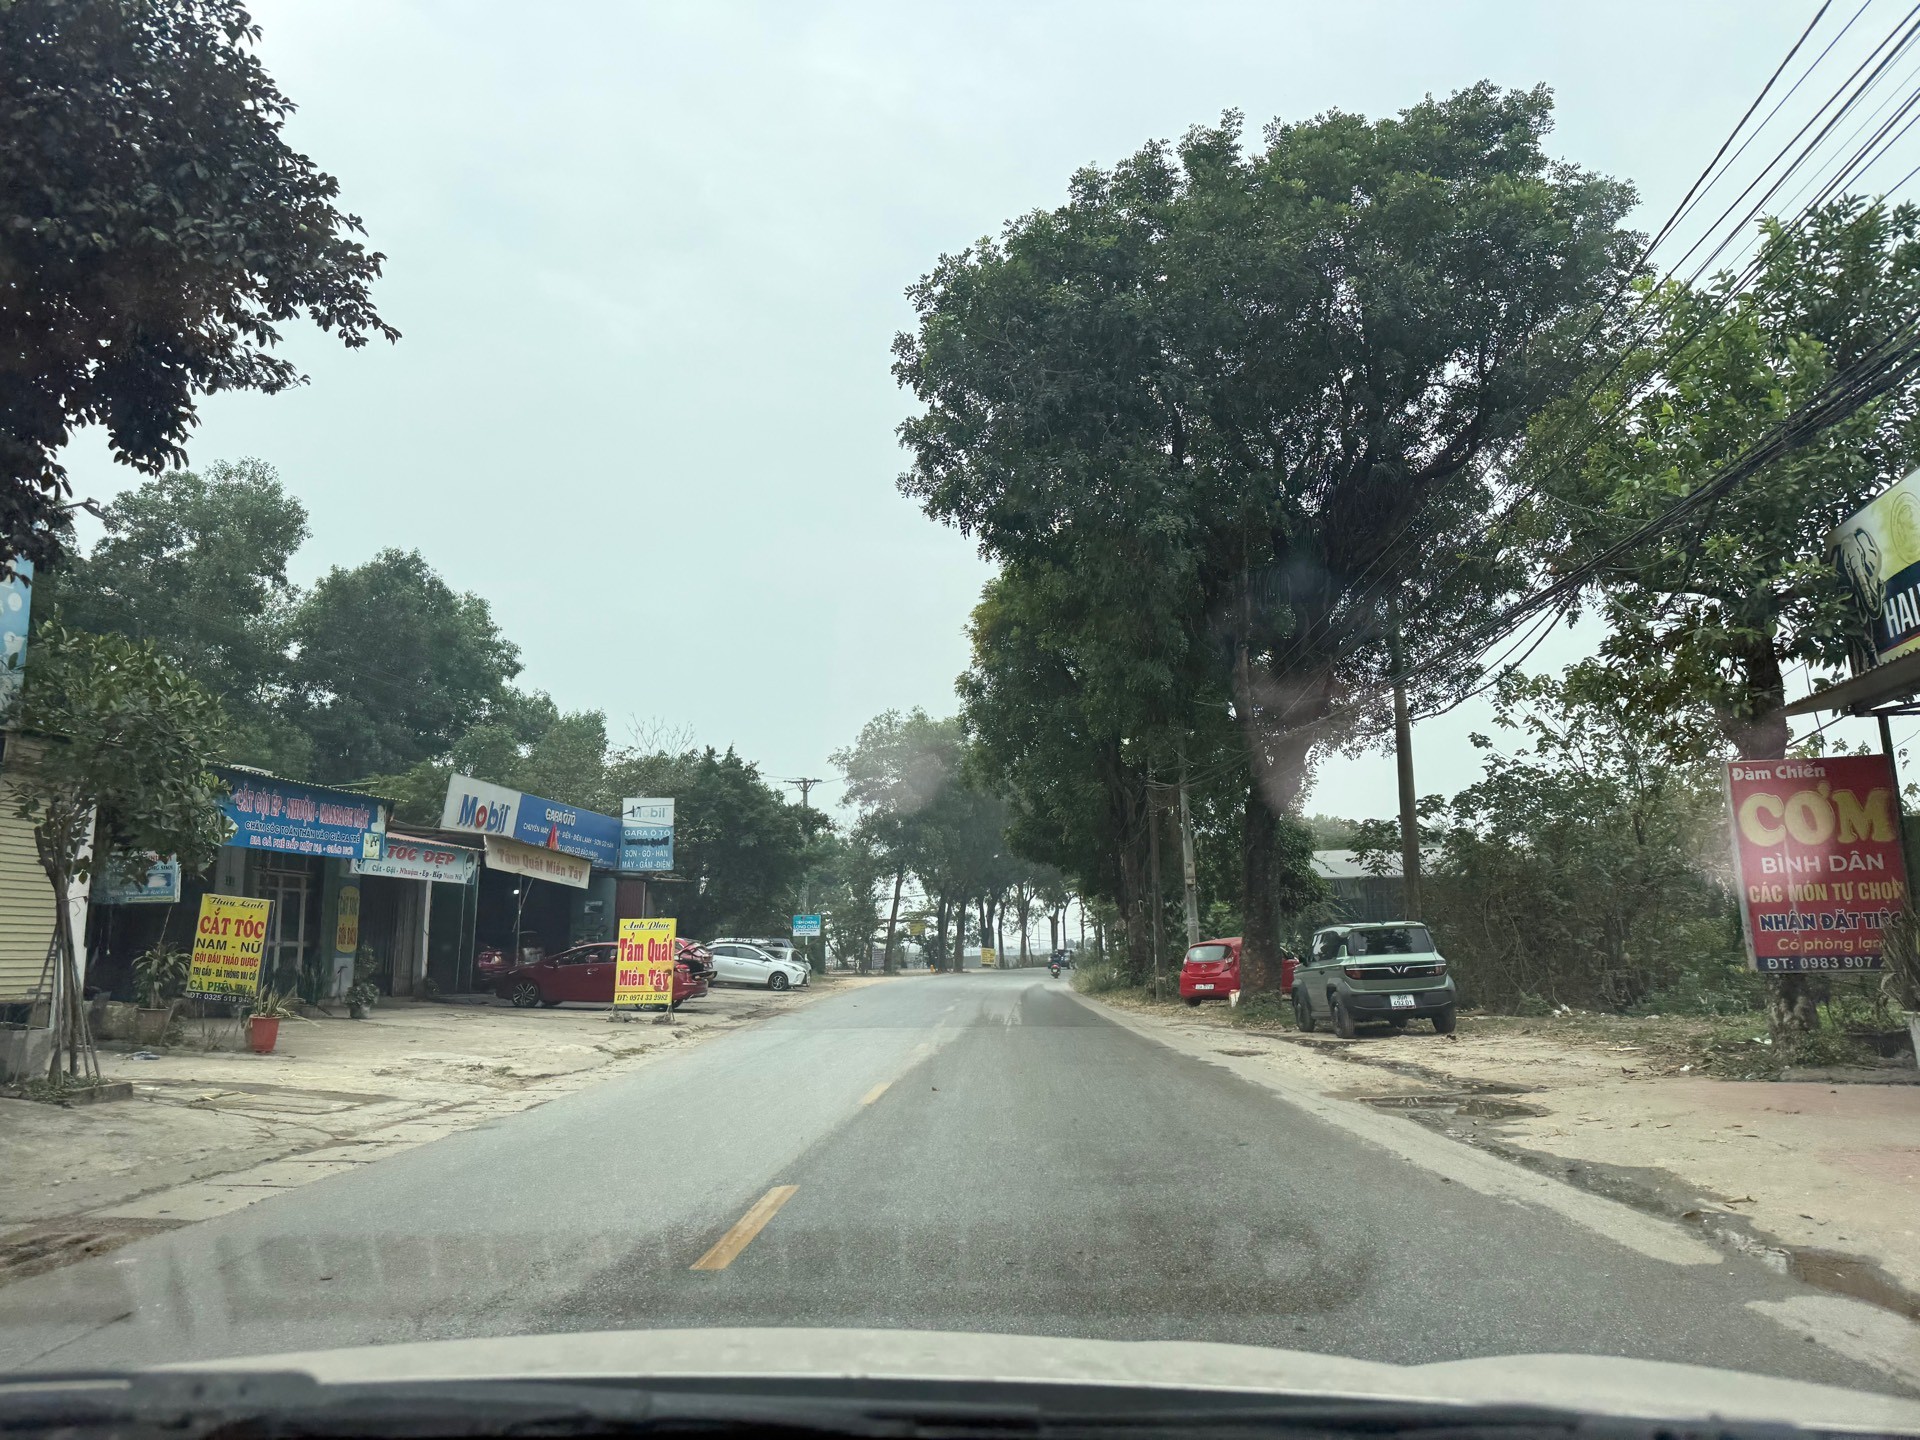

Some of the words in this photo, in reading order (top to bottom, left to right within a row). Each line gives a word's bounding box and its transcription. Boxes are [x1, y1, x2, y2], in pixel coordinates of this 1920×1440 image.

[1883, 582, 1920, 638] HAL
[1732, 766, 1771, 780] Đàm
[1776, 762, 1826, 779] Chiến
[457, 793, 511, 833] Mobil
[545, 808, 562, 824] GARA
[1739, 780, 1896, 846] CƠM
[624, 829, 648, 837] GARA
[387, 843, 418, 862] TÓC
[421, 850, 457, 869] ĐẸP
[1761, 853, 1821, 874] BÌNH
[1829, 851, 1884, 872] DÂN
[1749, 882, 1783, 903] CÁC
[1788, 881, 1829, 901] MÓN
[1831, 881, 1855, 904] TỰ
[200, 907, 231, 935] CẮT
[235, 915, 265, 939] TÓC
[1759, 909, 1819, 934] NHẬN
[1820, 908, 1860, 933] ĐẶT
[195, 938, 228, 951] NAM
[240, 940, 262, 954] NỮ
[619, 932, 645, 962] Tẩm
[647, 933, 673, 963] Quất
[1777, 938, 1800, 950] Có
[1804, 937, 1854, 953] phòng
[1767, 958, 1795, 969] ĐT:
[1800, 957, 1839, 969] 0983
[1844, 956, 1873, 968] 907
[189, 977, 204, 991] CÀ
[619, 967, 645, 986] Miền
[648, 968, 670, 991] Tây
[203, 993, 222, 1001] 0325
